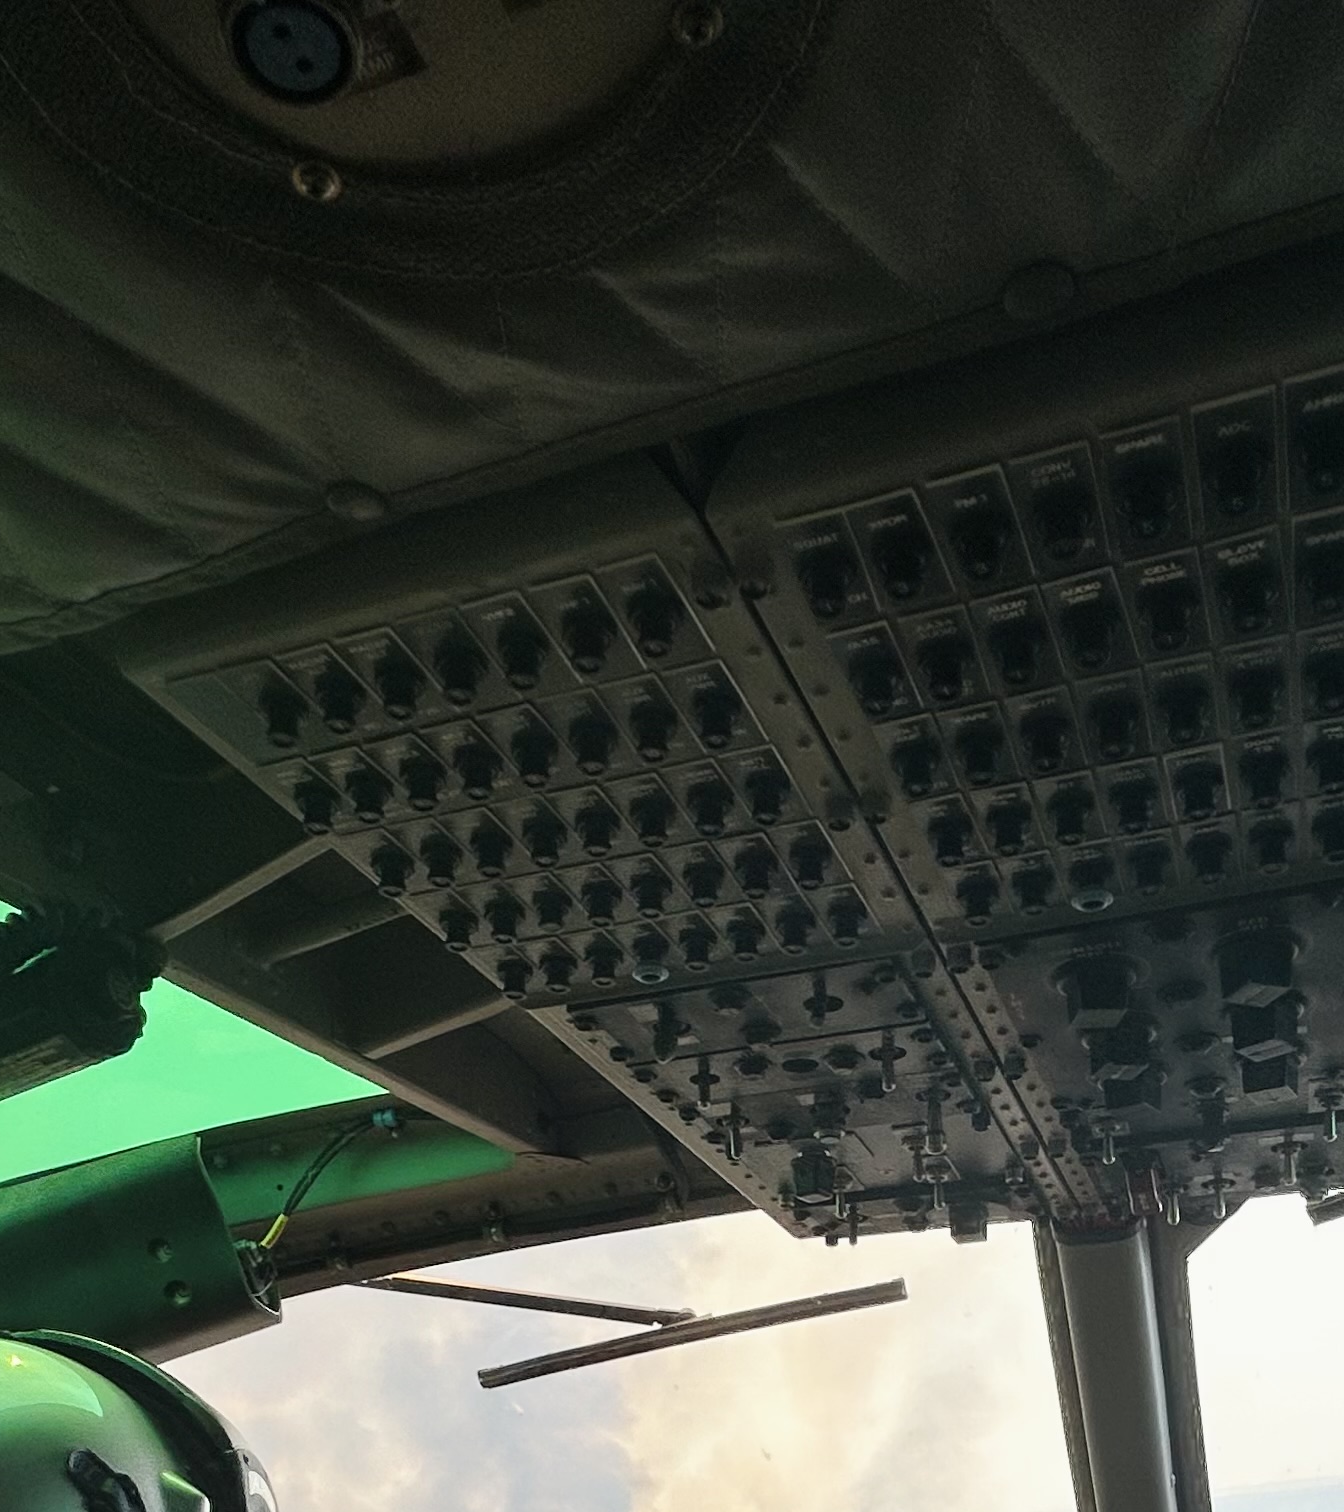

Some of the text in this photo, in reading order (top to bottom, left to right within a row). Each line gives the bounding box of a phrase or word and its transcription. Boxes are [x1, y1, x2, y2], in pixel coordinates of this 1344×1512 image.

[1217, 419, 1252, 438] ADC
[1060, 581, 1102, 599] AUDIO
[988, 599, 1027, 616] AUDIO
